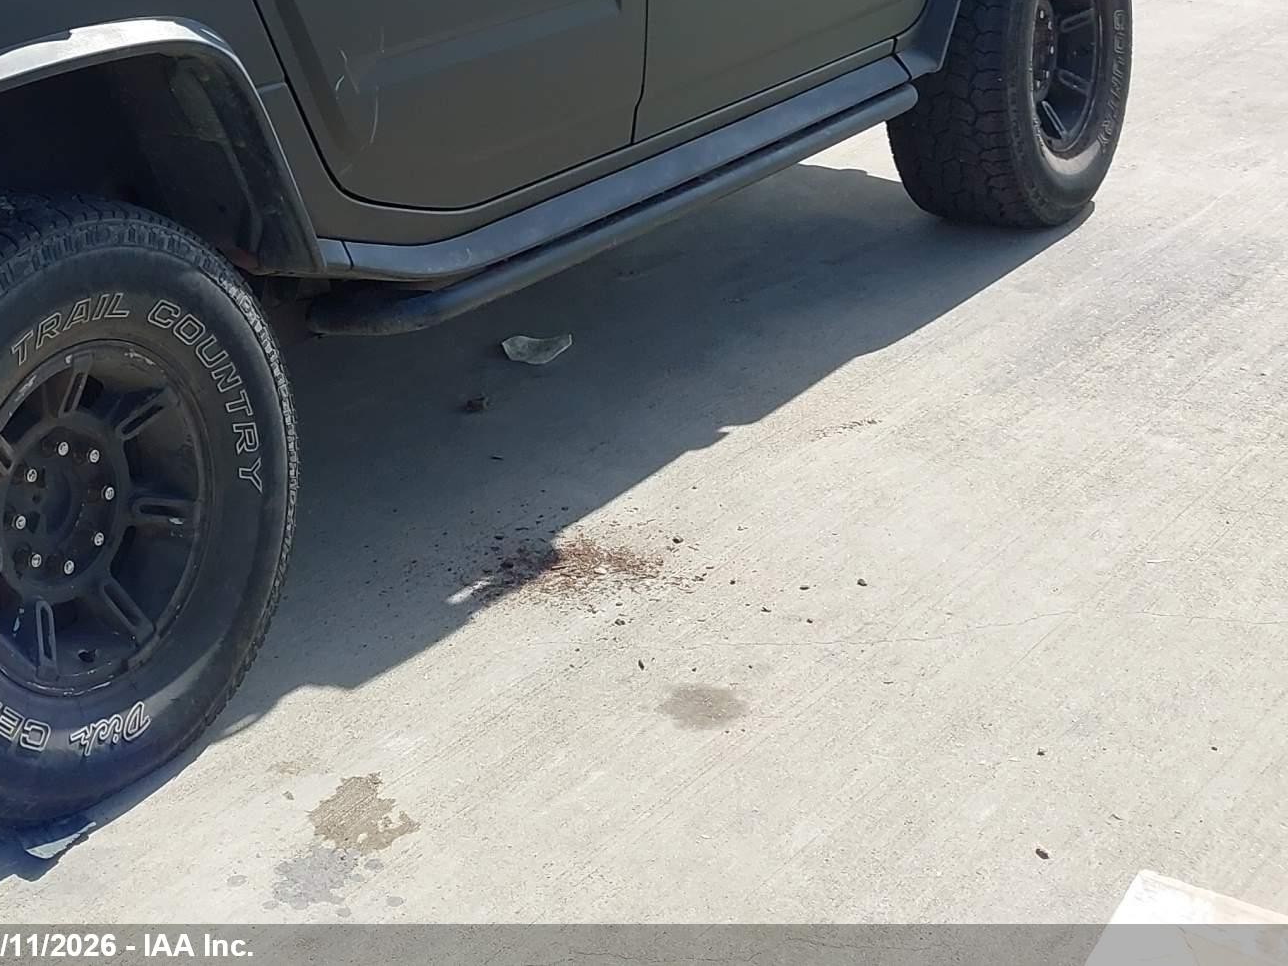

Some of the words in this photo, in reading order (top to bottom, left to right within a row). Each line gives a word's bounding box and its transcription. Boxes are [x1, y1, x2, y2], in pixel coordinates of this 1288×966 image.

[11, 291, 130, 367] TRAIL
[147, 298, 263, 493] COUNTRY
[70, 700, 152, 757] Dick
